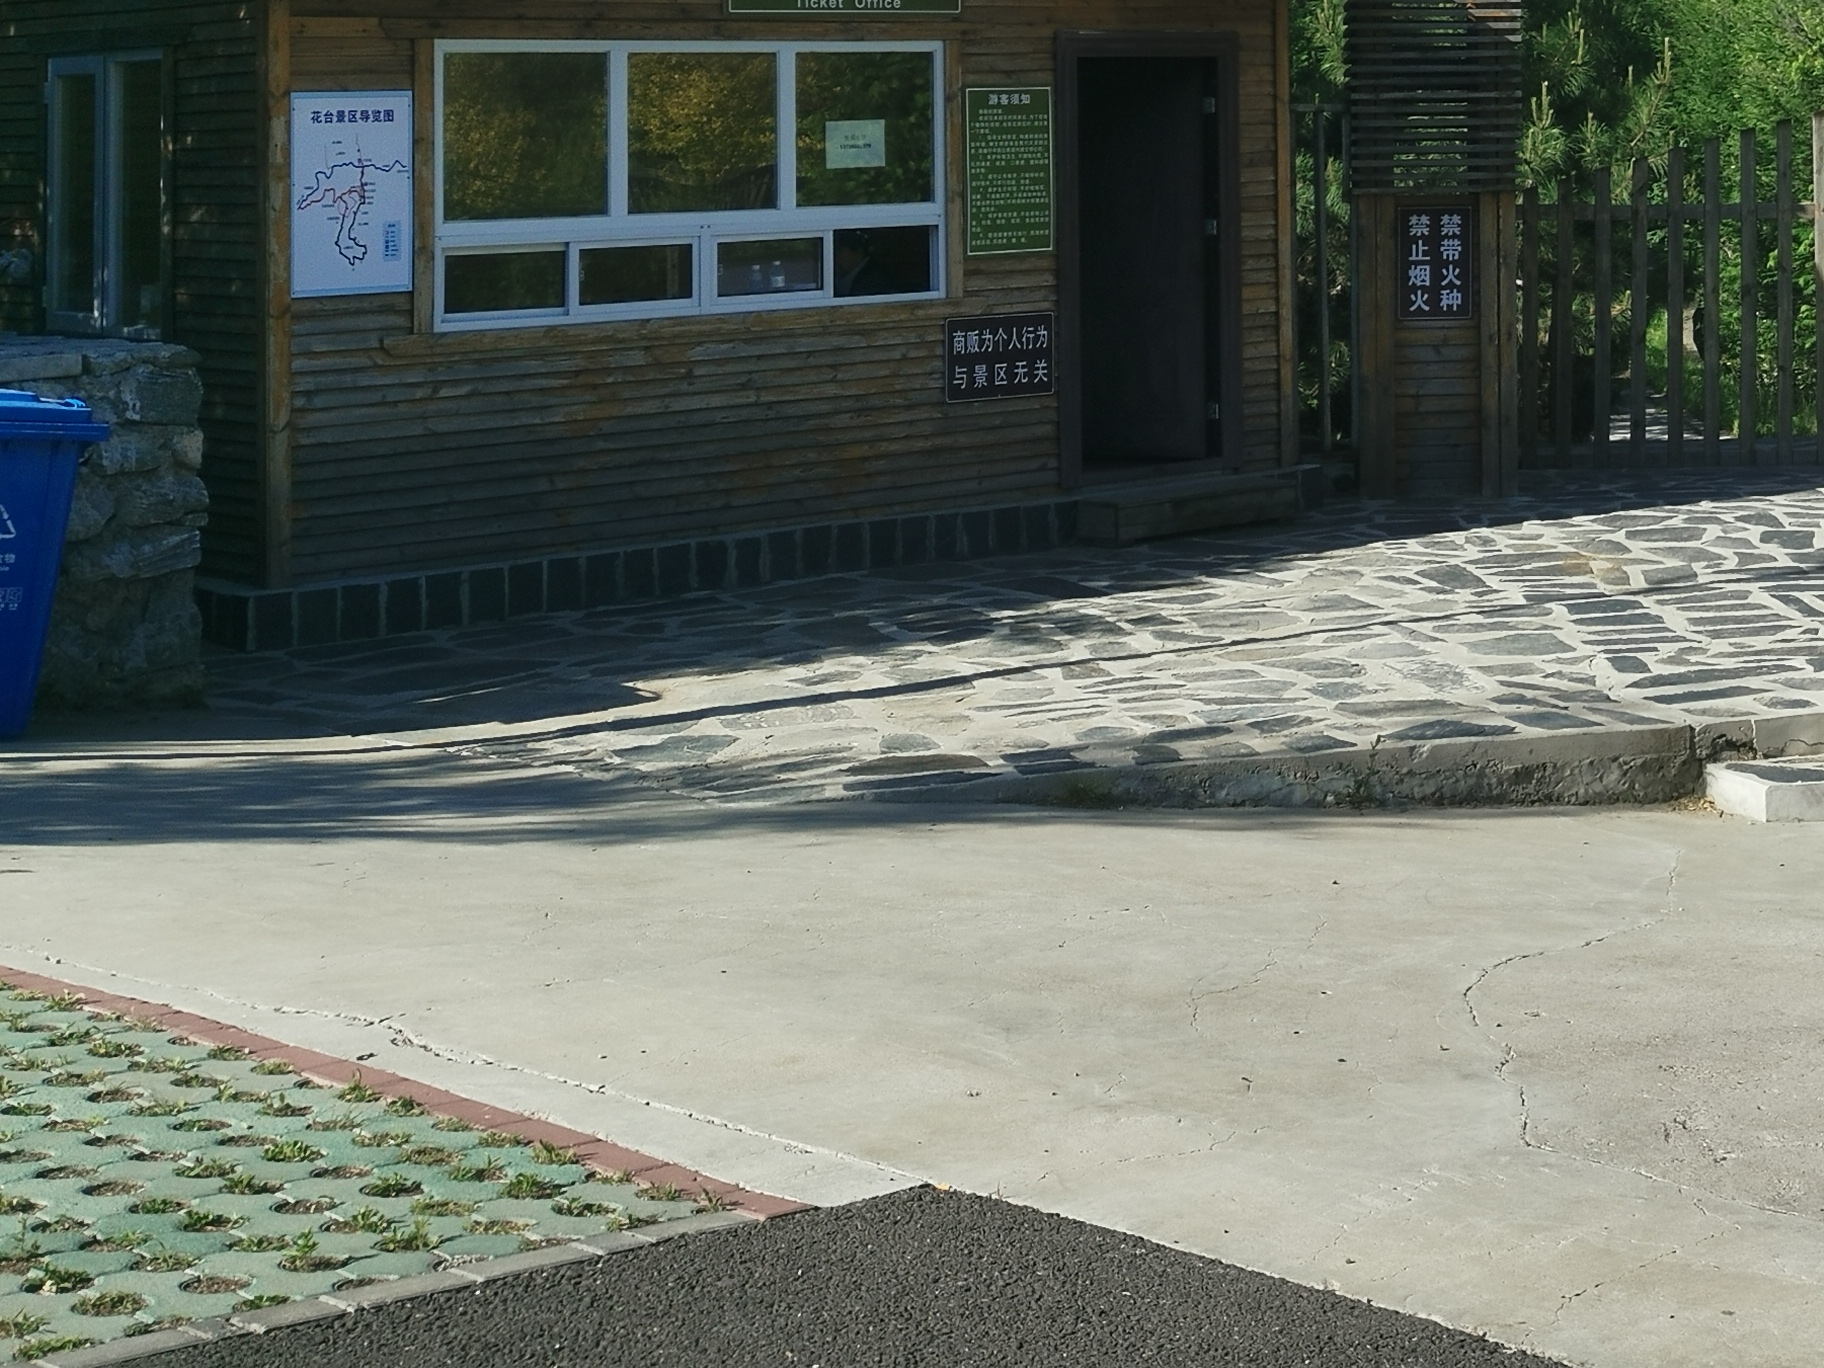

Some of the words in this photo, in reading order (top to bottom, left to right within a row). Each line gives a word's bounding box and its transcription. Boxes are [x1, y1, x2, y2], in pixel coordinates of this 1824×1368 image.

[310, 109, 395, 124] 花台景区导览图
[1408, 214, 1431, 312] 禁止烟火
[1440, 214, 1462, 312] 禁带火种
[952, 324, 1048, 355] 商贩为个人行为
[952, 359, 1048, 389] 与景区无关
